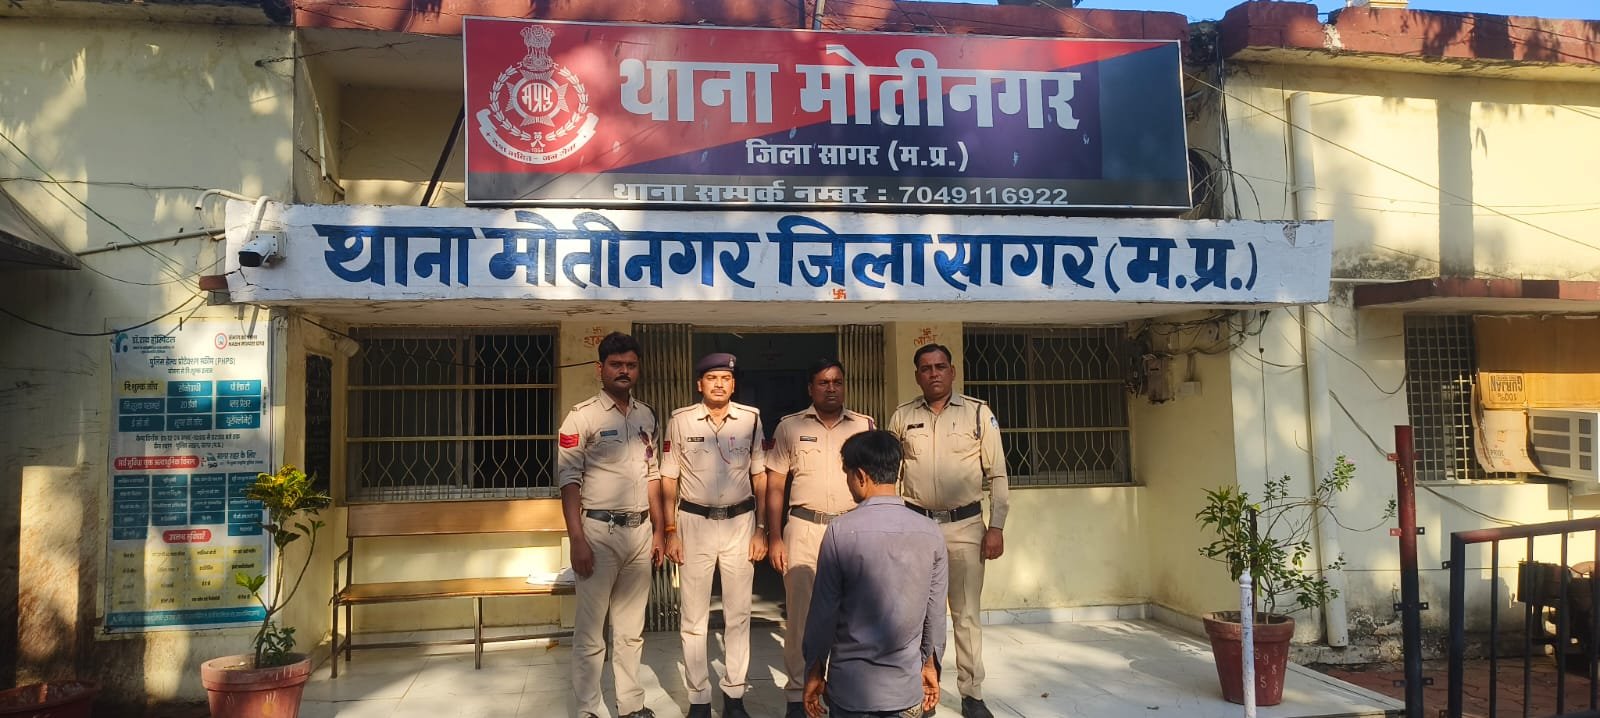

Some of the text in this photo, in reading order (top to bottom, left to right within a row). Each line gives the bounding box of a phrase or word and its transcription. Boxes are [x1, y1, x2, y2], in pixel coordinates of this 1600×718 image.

[620, 44, 1081, 131] थाना मोतीनगर
[746, 137, 970, 172] जिला सागर (म.प्र.)
[613, 183, 687, 202] थाना
[696, 180, 786, 203] सम्पर्क
[794, 185, 869, 203] नम्बर
[898, 186, 1069, 205] 7049116922
[312, 209, 1259, 294] थाना मोतीनगर जिला सागर (म.प्र.)
